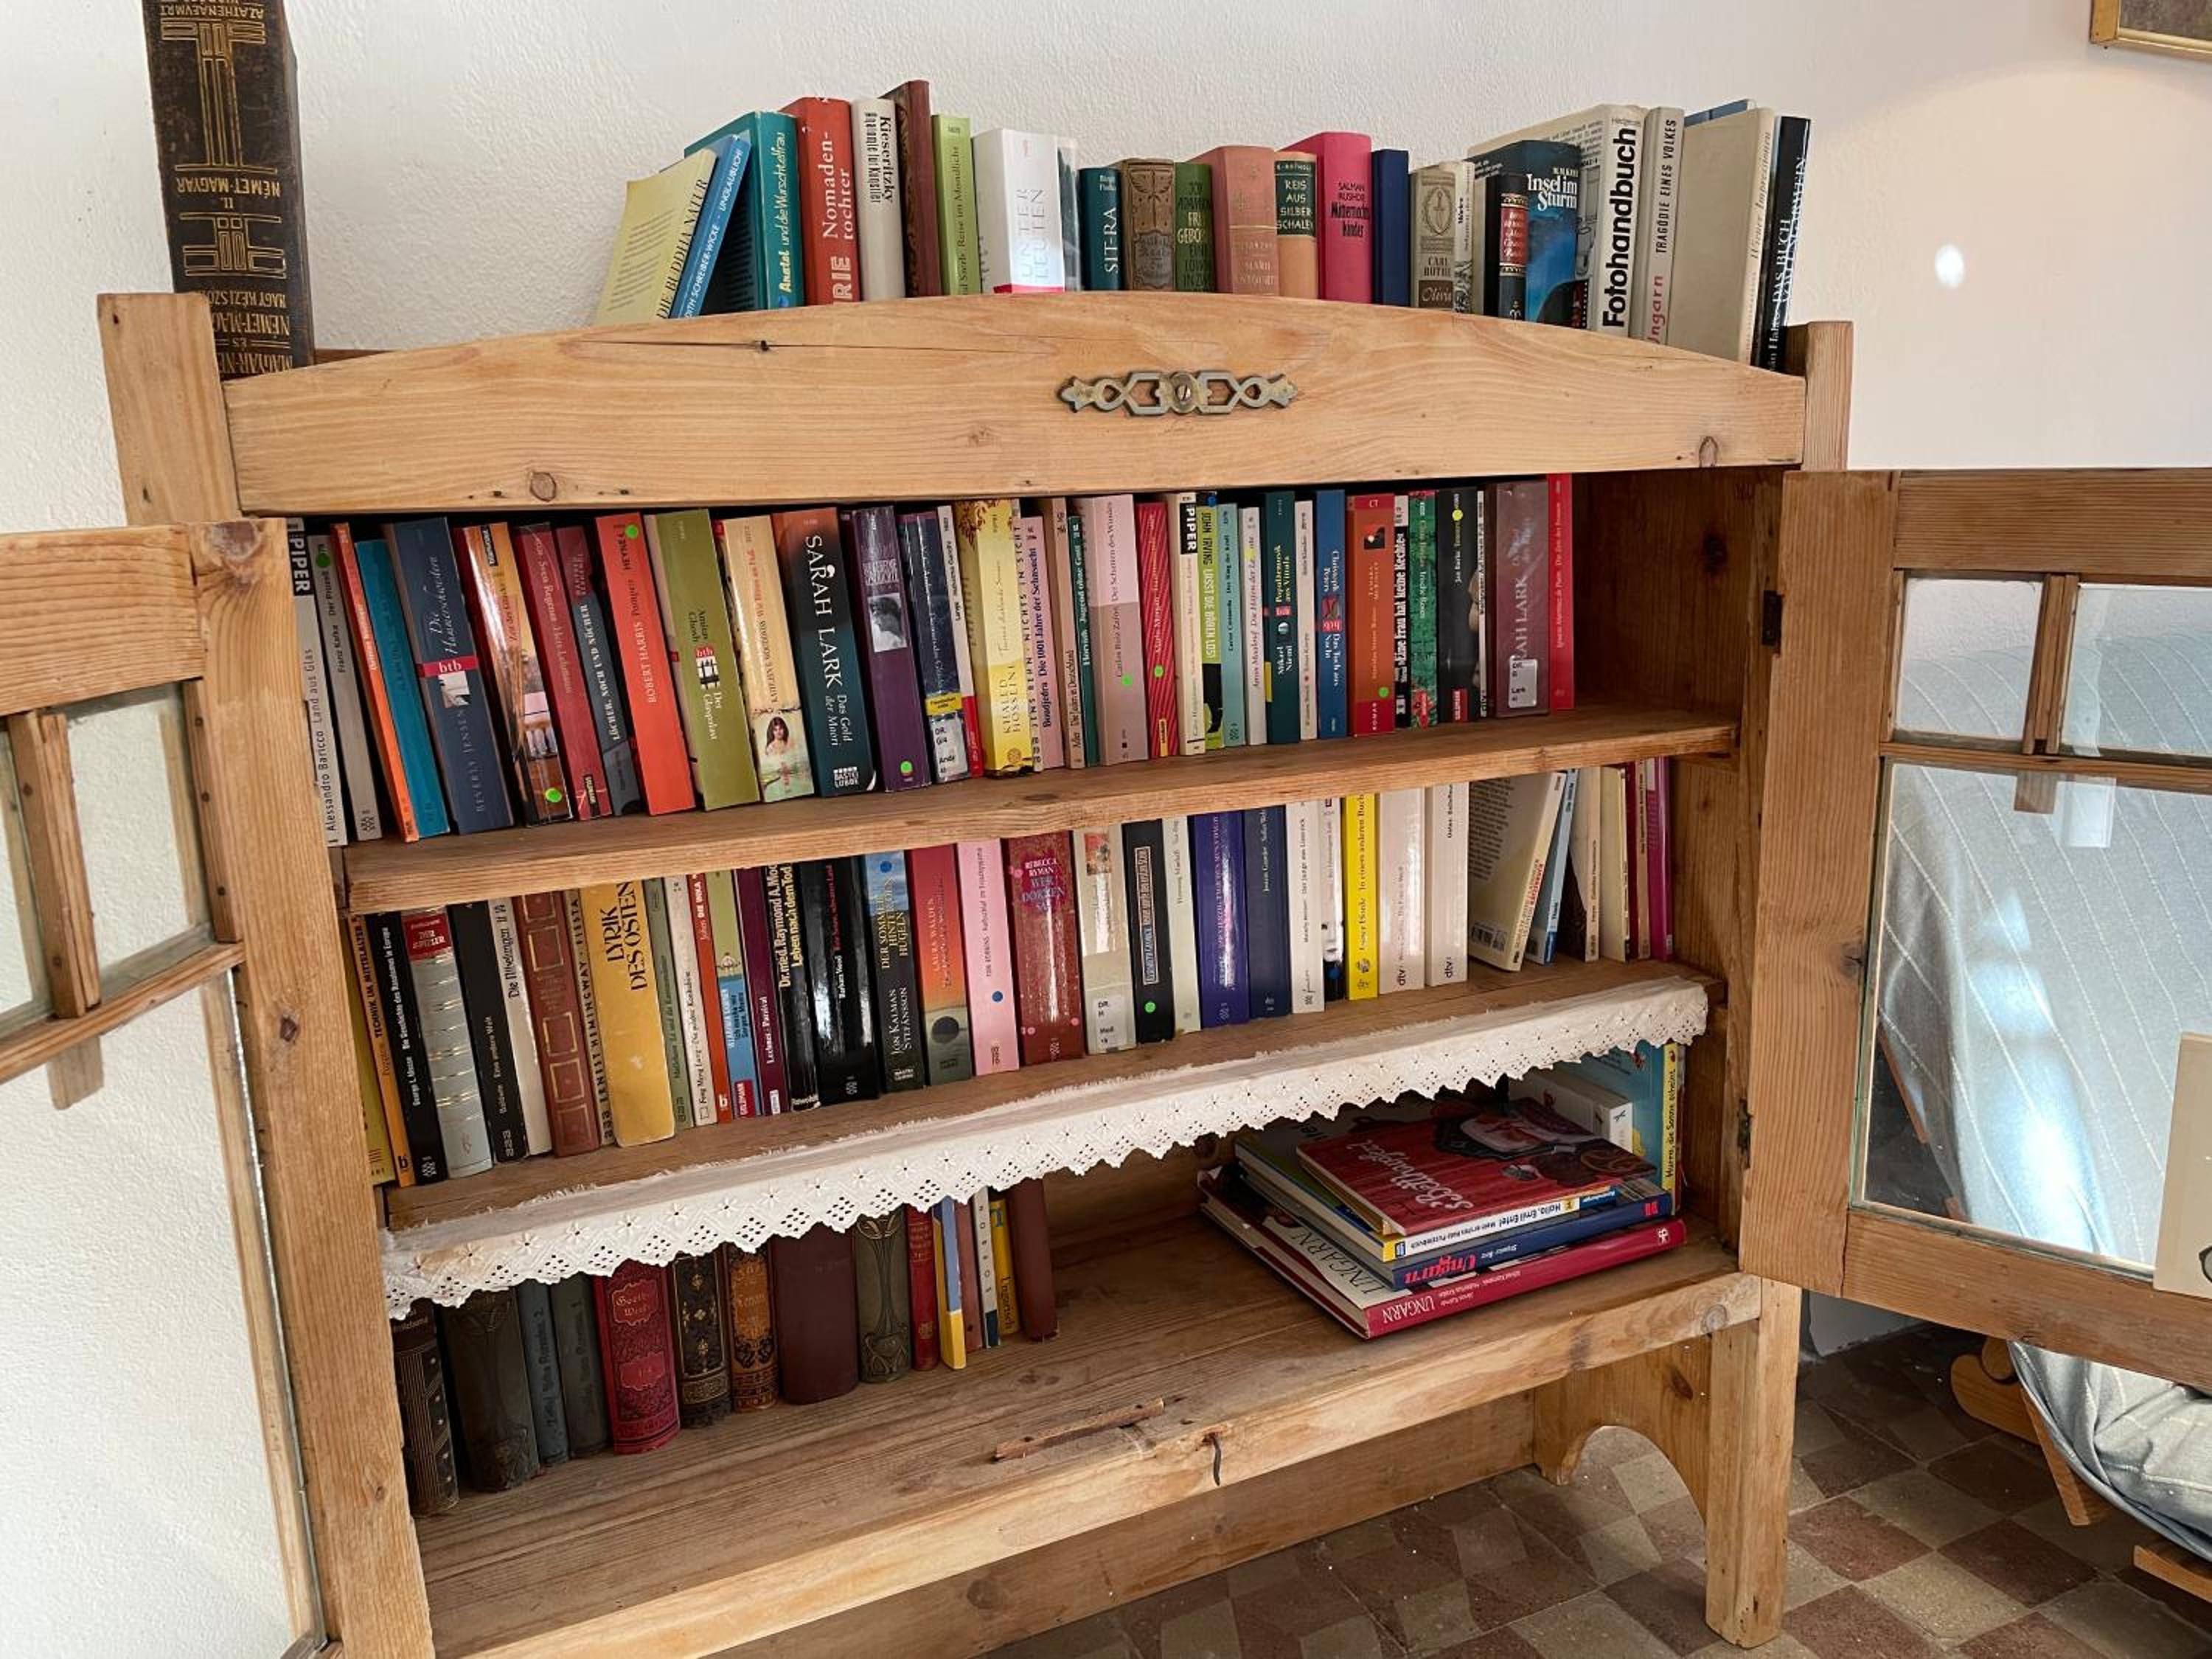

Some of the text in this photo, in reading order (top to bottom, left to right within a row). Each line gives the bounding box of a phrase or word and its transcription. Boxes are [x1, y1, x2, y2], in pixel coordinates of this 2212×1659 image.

[1663, 119, 1676, 159] VOLKES
[880, 116, 896, 204] Kieseritzky
[819, 131, 840, 239] Nomaden-
[840, 169, 854, 240] tochter
[1286, 193, 1306, 203] AUS
[1538, 191, 1577, 212] Sturm
[1602, 127, 1636, 327] Fotohandbuch
[1187, 505, 1197, 551] PIPER
[291, 539, 311, 592] PIPER
[1204, 537, 1214, 565] IRVING
[804, 535, 843, 689] SARAH LARK
[1395, 601, 1406, 616] hat
[1516, 575, 1529, 623] LARK
[305, 648, 316, 672] Glas
[636, 621, 650, 660] HARRIS
[1039, 659, 1048, 677] Die
[310, 698, 322, 723] Land
[836, 695, 853, 742] Das Gold
[317, 731, 330, 771] Baricco
[321, 773, 337, 832] Alessandro
[600, 906, 625, 961] LYRIK
[616, 882, 648, 990] DES OSTEN
[772, 899, 788, 947] Raymond
[782, 866, 804, 967] Leben nach dem Tod
[880, 947, 891, 968] DER
[1444, 961, 1454, 978] dtv
[1397, 970, 1407, 987] dtv
[1518, 1207, 1537, 1223] Emil
[1402, 1253, 1476, 1285] Ungarn
[1382, 1295, 1435, 1324] UNGARN
